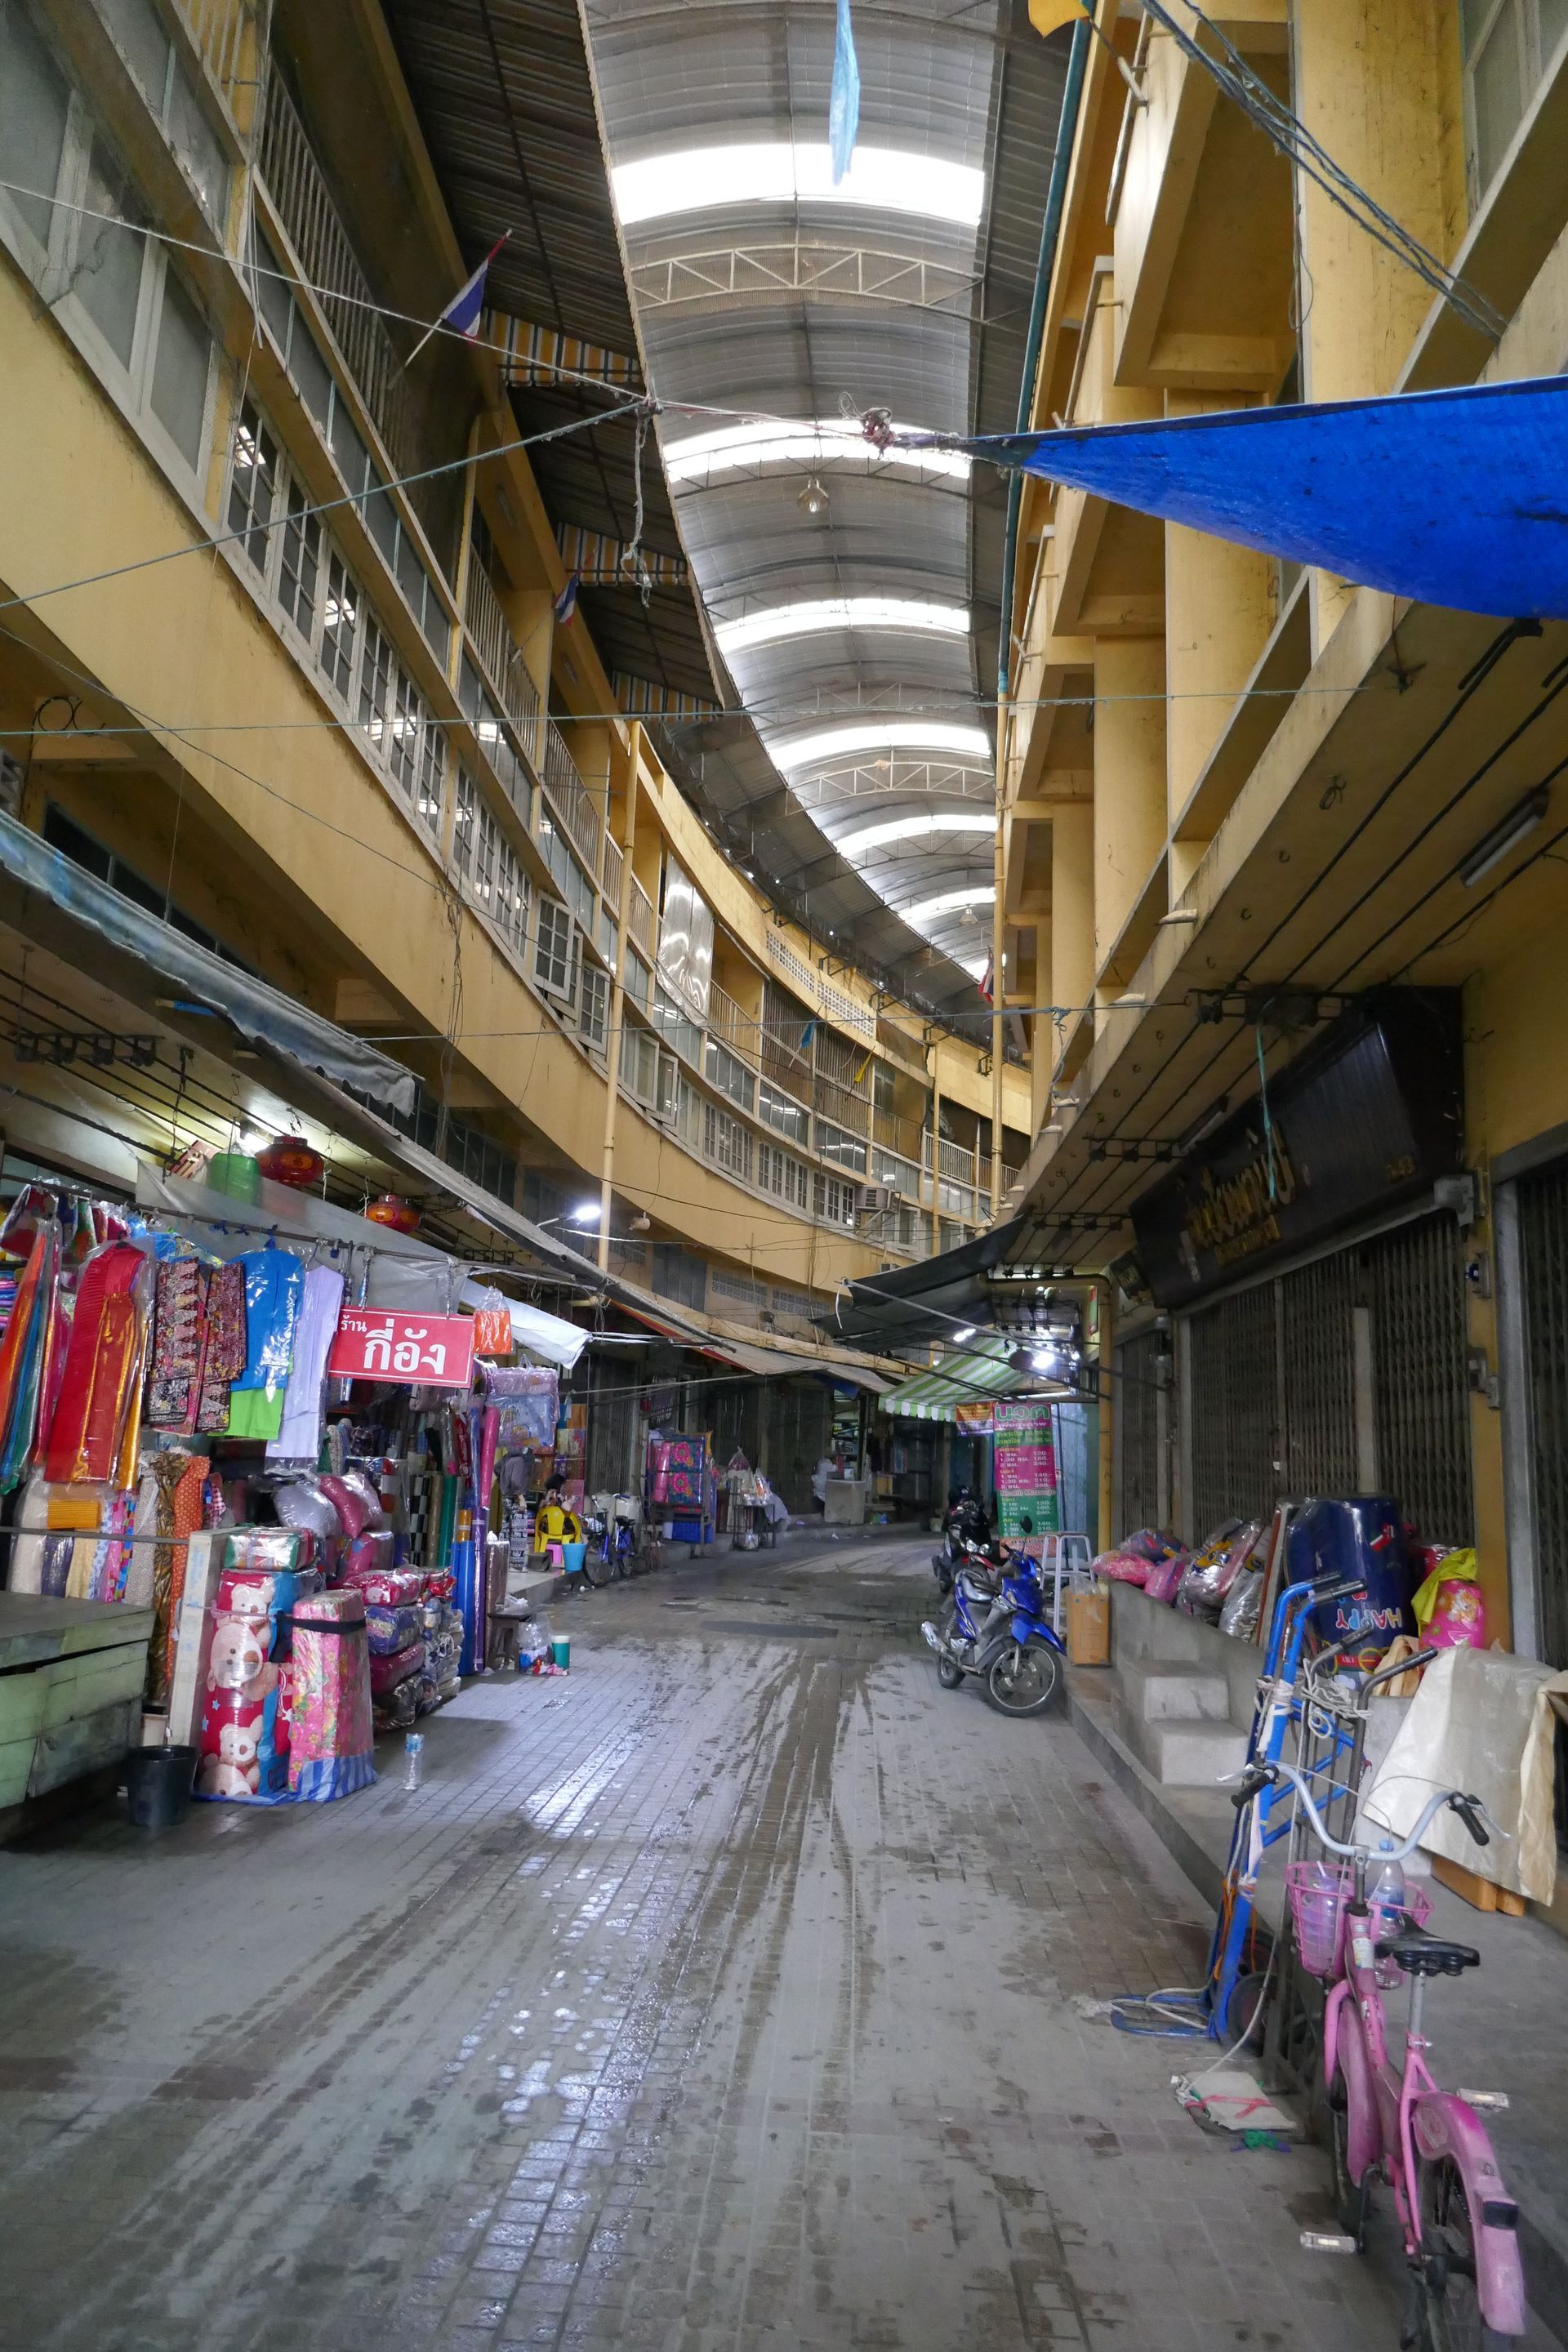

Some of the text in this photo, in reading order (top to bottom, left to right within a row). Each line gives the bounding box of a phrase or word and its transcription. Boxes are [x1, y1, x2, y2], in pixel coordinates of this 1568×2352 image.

[340, 1314, 368, 1333] ร้าน
[363, 1318, 447, 1375] กี่อัง
[994, 1404, 1050, 1422] นวด
[1334, 1606, 1404, 1630] HAPPY
